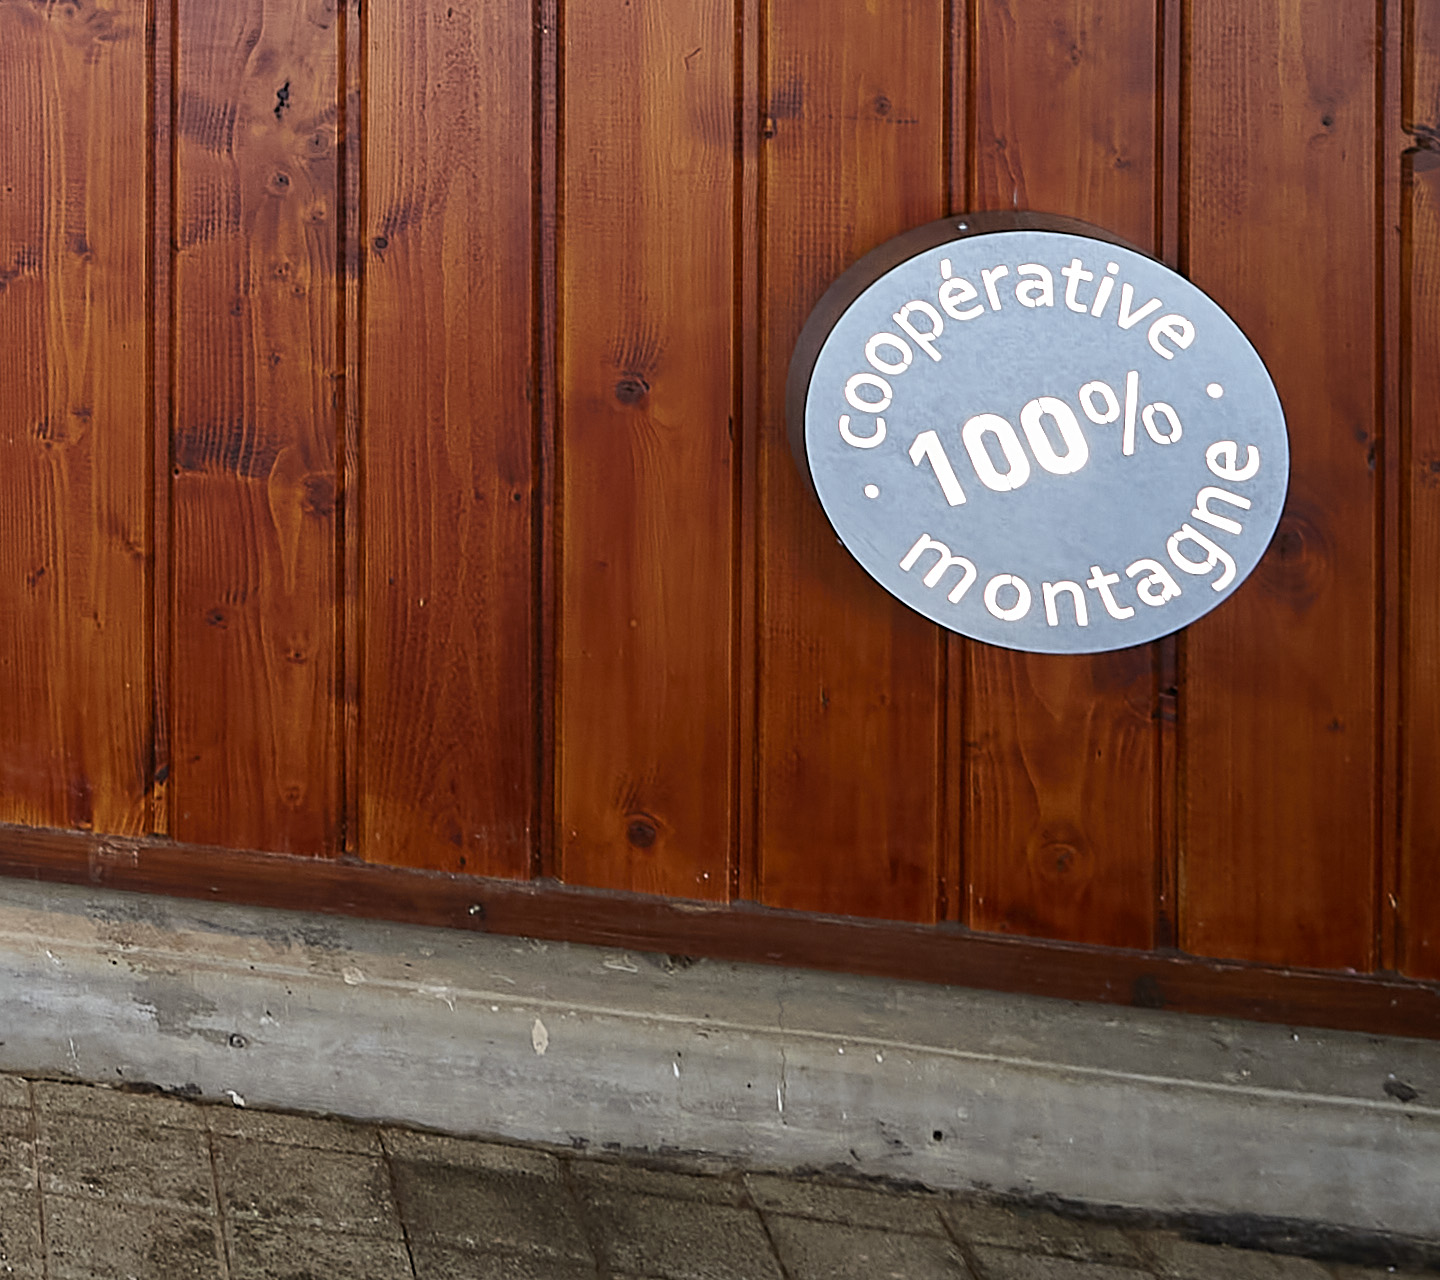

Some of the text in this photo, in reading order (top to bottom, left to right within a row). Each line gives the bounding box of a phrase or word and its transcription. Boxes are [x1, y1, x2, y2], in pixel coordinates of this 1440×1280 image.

[839, 258, 1196, 449] coopérative
[909, 370, 1182, 507] 100%
[899, 439, 1260, 628] montagne
